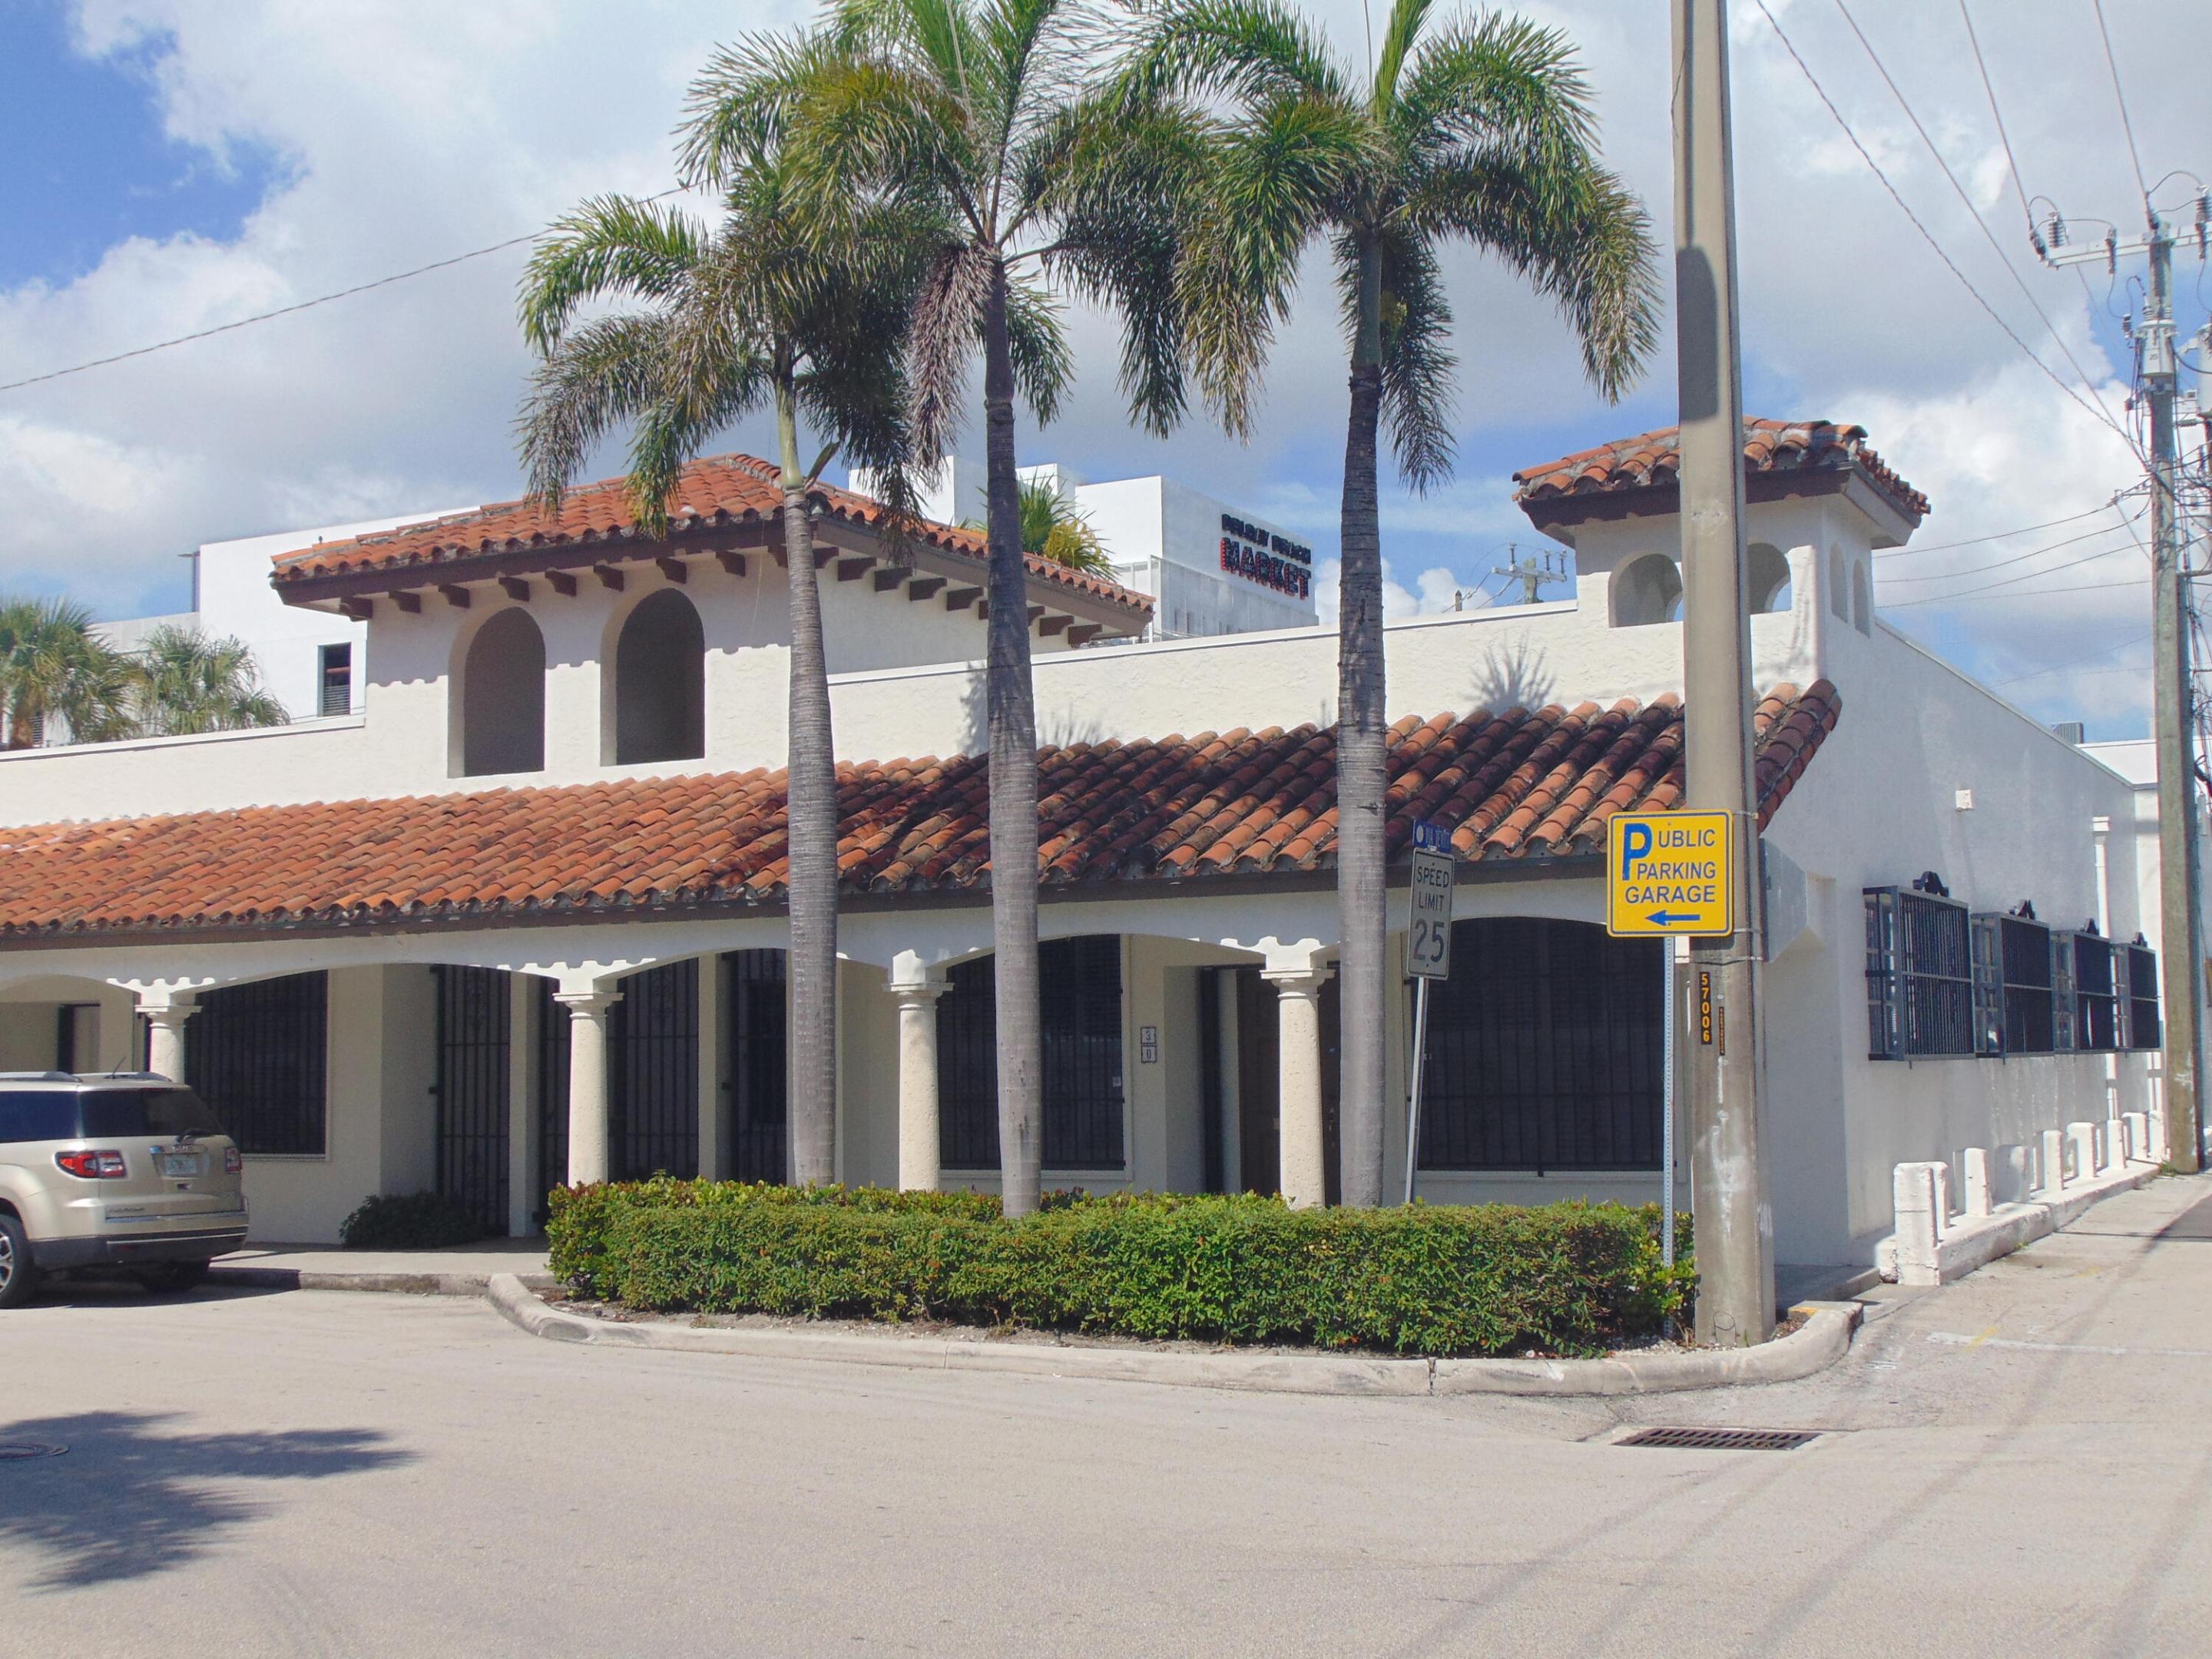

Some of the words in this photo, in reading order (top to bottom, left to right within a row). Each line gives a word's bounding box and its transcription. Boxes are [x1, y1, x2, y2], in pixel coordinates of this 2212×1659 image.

[1220, 537, 1312, 600] MARKET
[1622, 823, 1716, 881] PUBLIC
[1416, 865, 1449, 889] SPEED
[1637, 861, 1716, 881] PARKING
[1418, 892, 1445, 912] LIMIT
[1624, 885, 1716, 904] GARAGE
[1412, 917, 1445, 963] 25
[1701, 973, 1710, 1042] 57006
